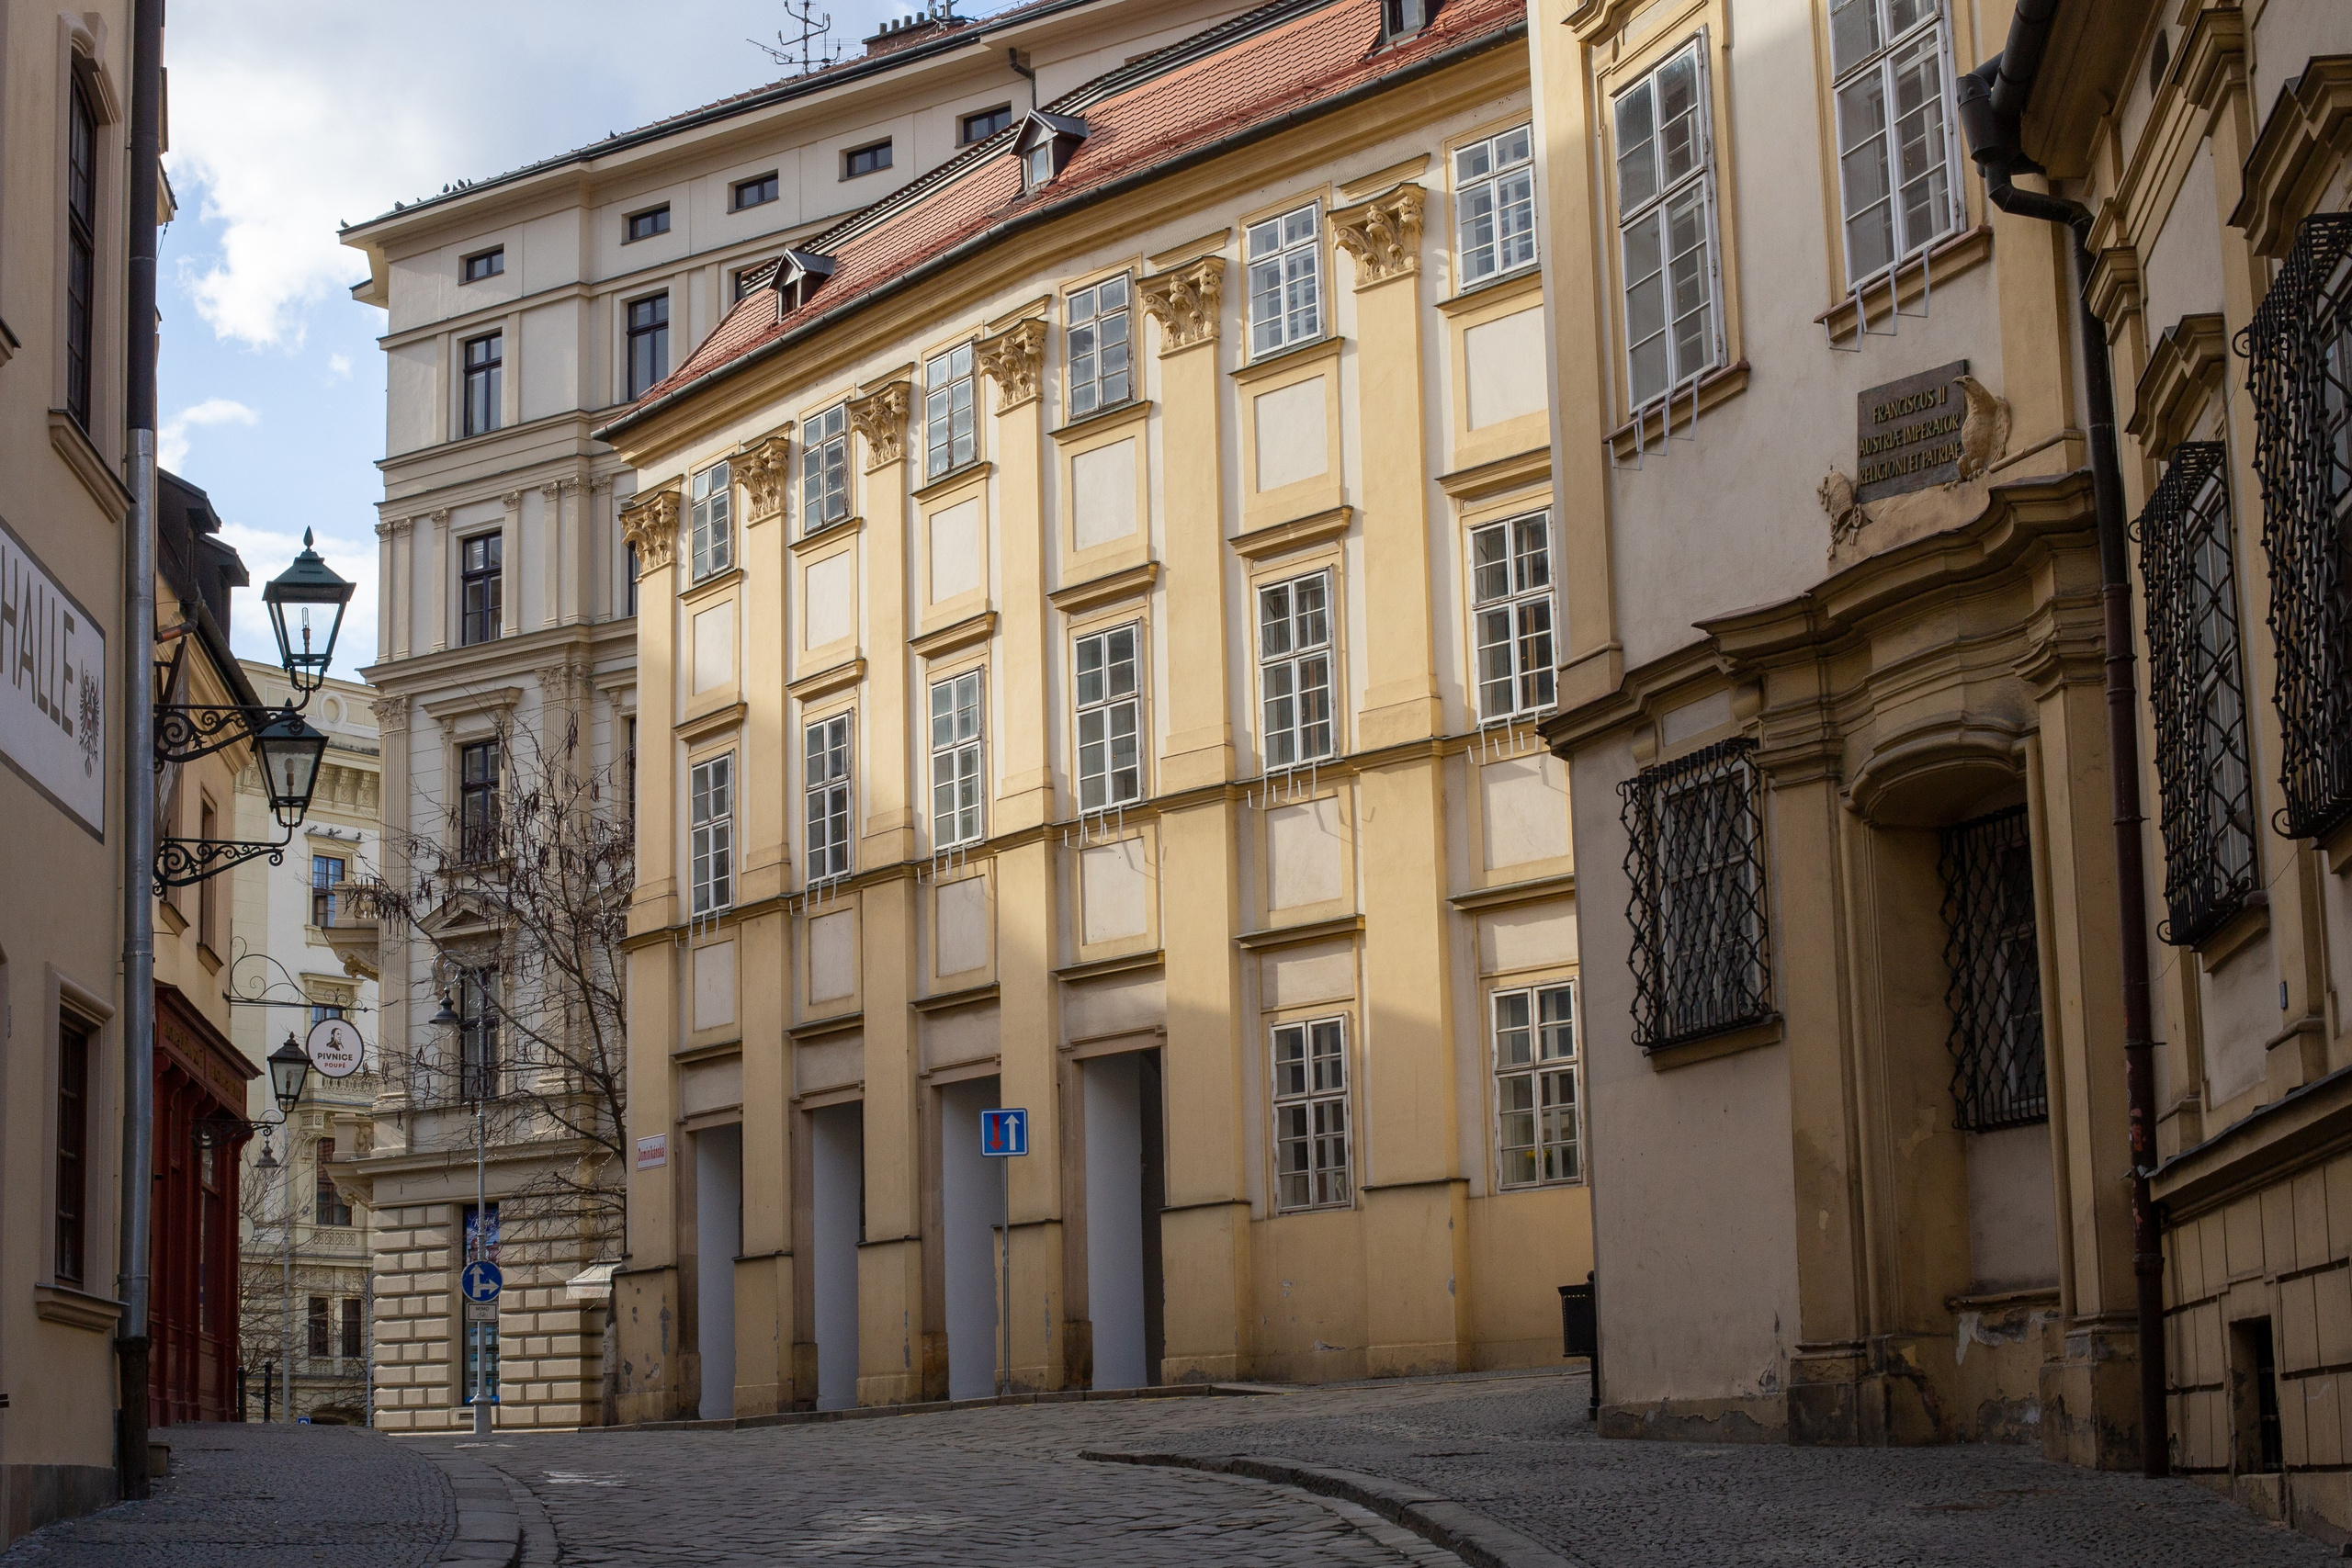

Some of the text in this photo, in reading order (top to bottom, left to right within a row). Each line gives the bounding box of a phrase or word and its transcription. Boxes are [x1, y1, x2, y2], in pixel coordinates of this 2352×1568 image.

[1872, 386, 1947, 423] FRANCISCUS II
[1904, 412, 1960, 445] IMPERATOR
[1859, 456, 1906, 486] RELIGIONI
[1909, 454, 1919, 472] ET
[0, 545, 74, 738] HALLE
[317, 1053, 353, 1061] PIVNICE
[638, 1143, 664, 1162] Dominikánská
